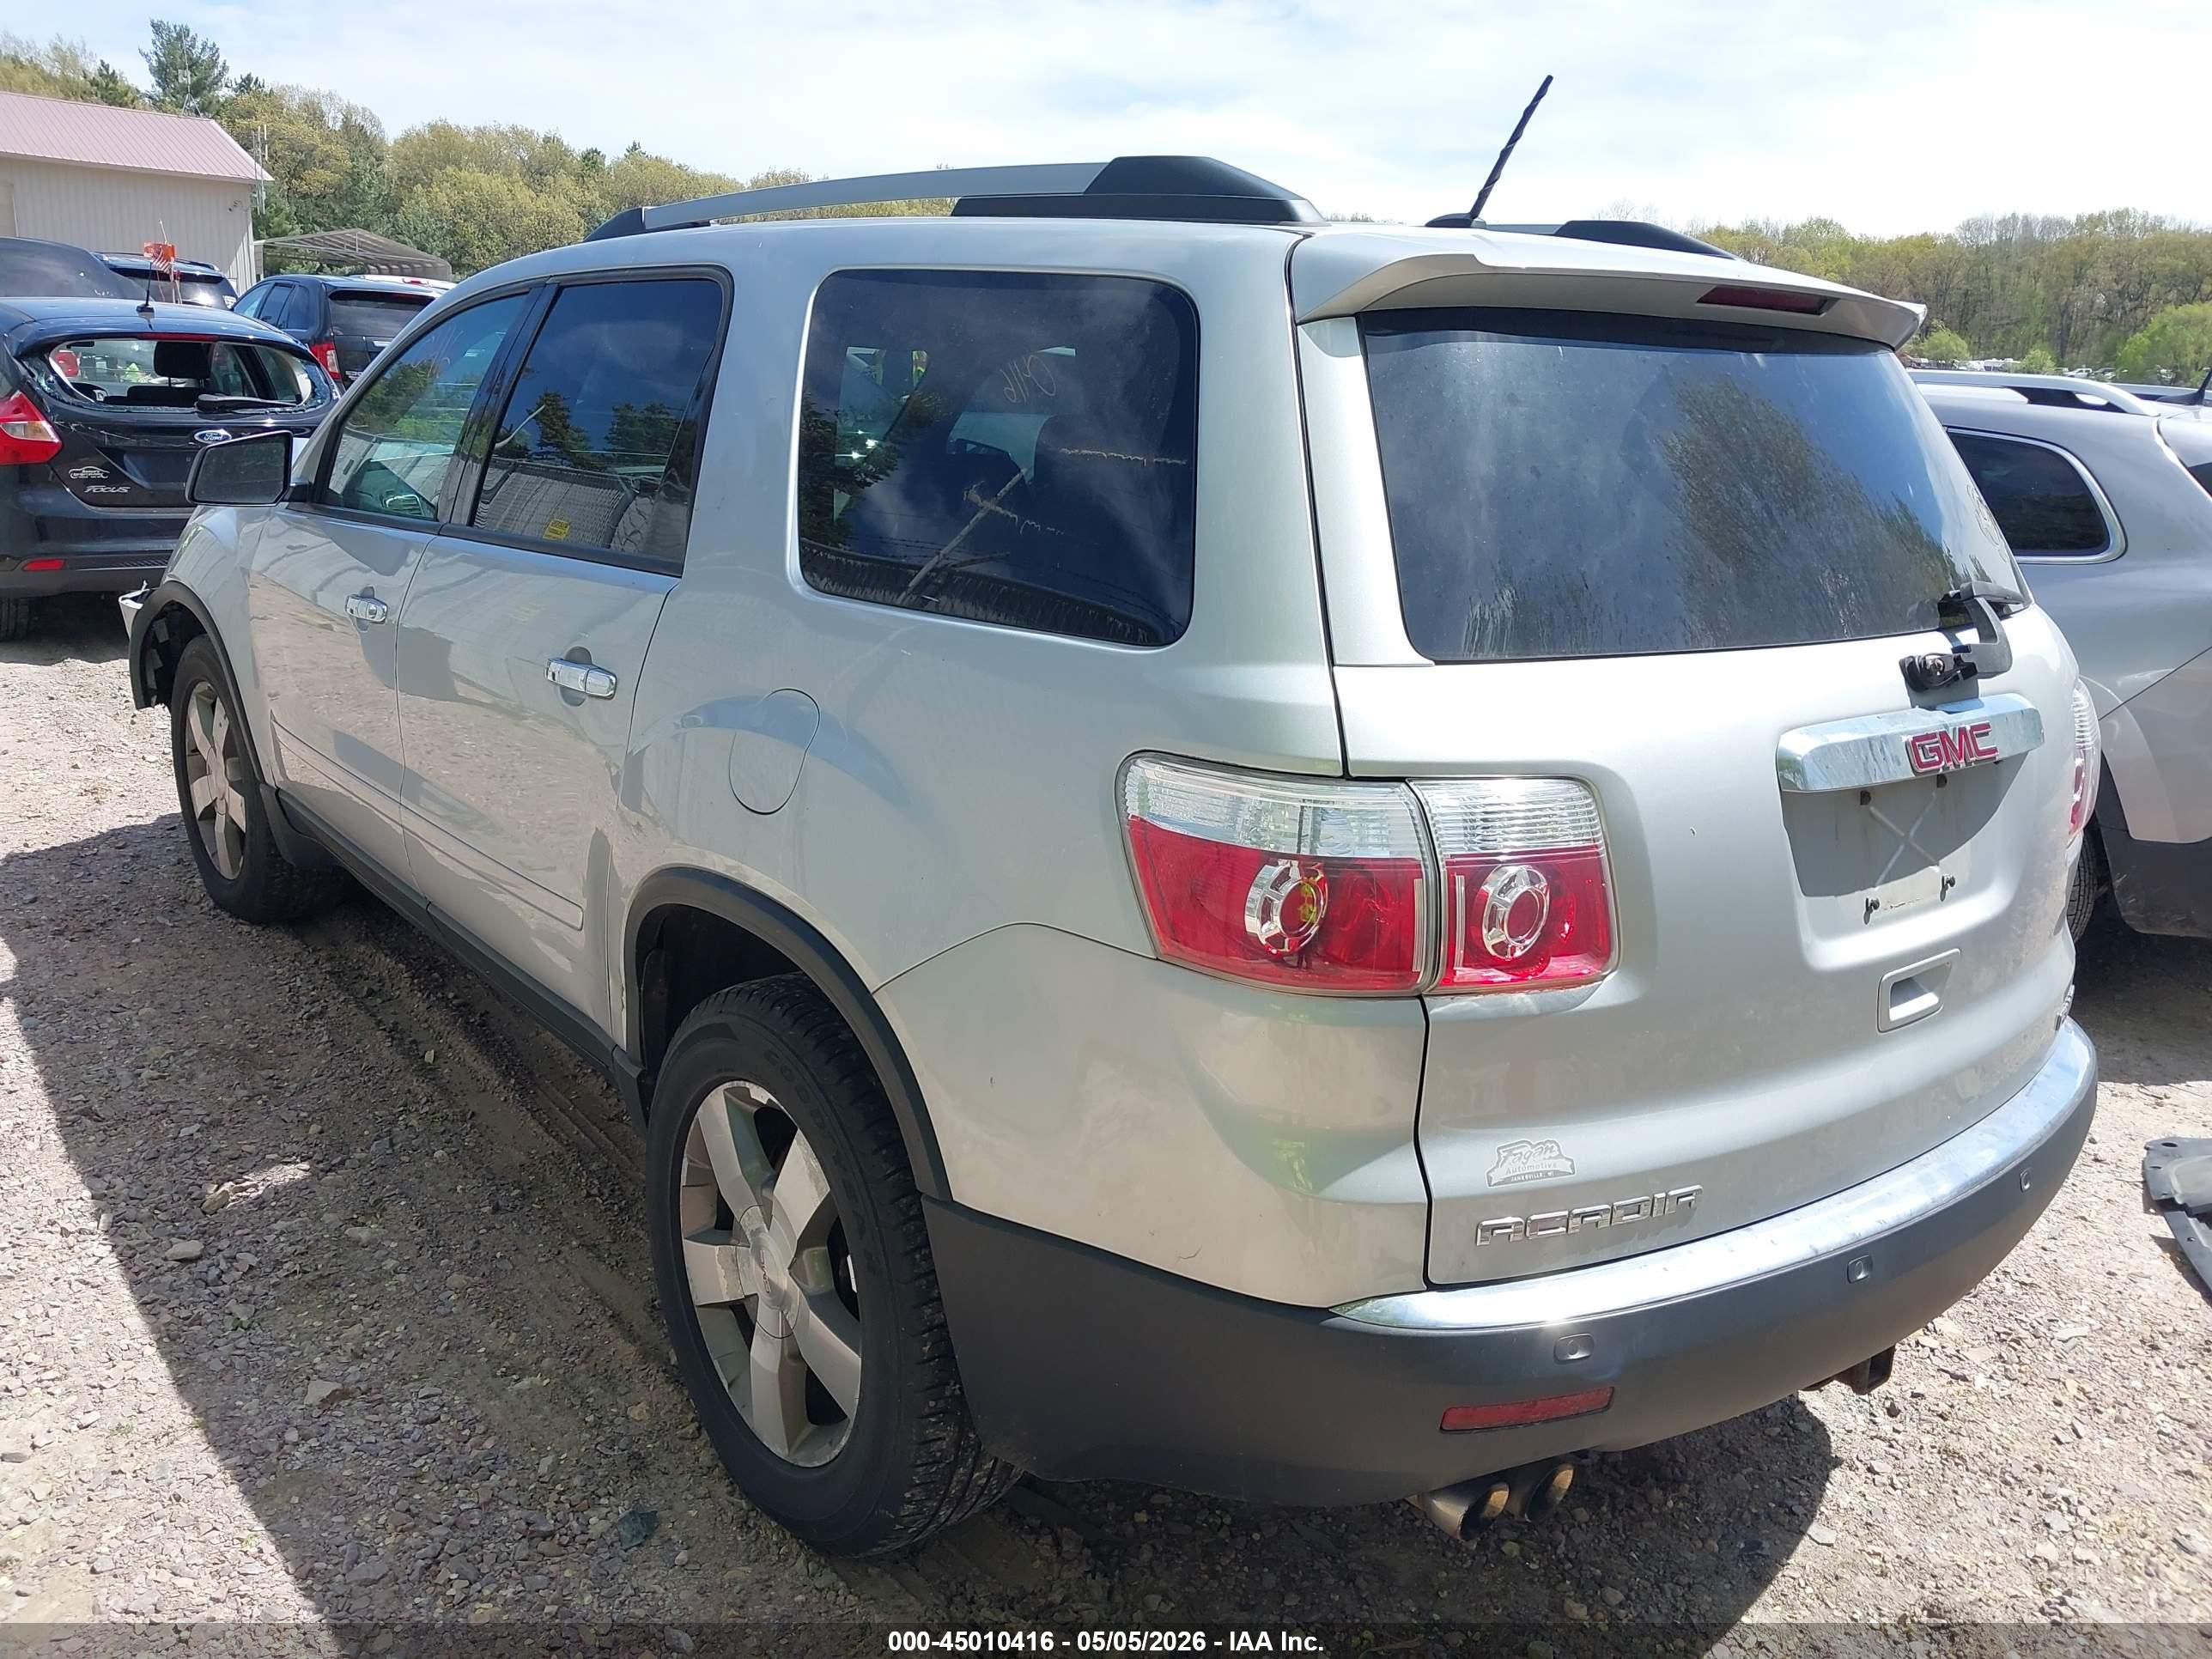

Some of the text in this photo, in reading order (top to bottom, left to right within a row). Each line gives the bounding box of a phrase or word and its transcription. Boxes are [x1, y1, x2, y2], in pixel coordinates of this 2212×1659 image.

[84, 484, 131, 494] FOCUS
[1906, 720, 1999, 774] GMC
[1499, 1143, 1559, 1169] Fagan
[1505, 1161, 1558, 1175] Automotive
[1476, 1184, 1704, 1247] ACADIA
